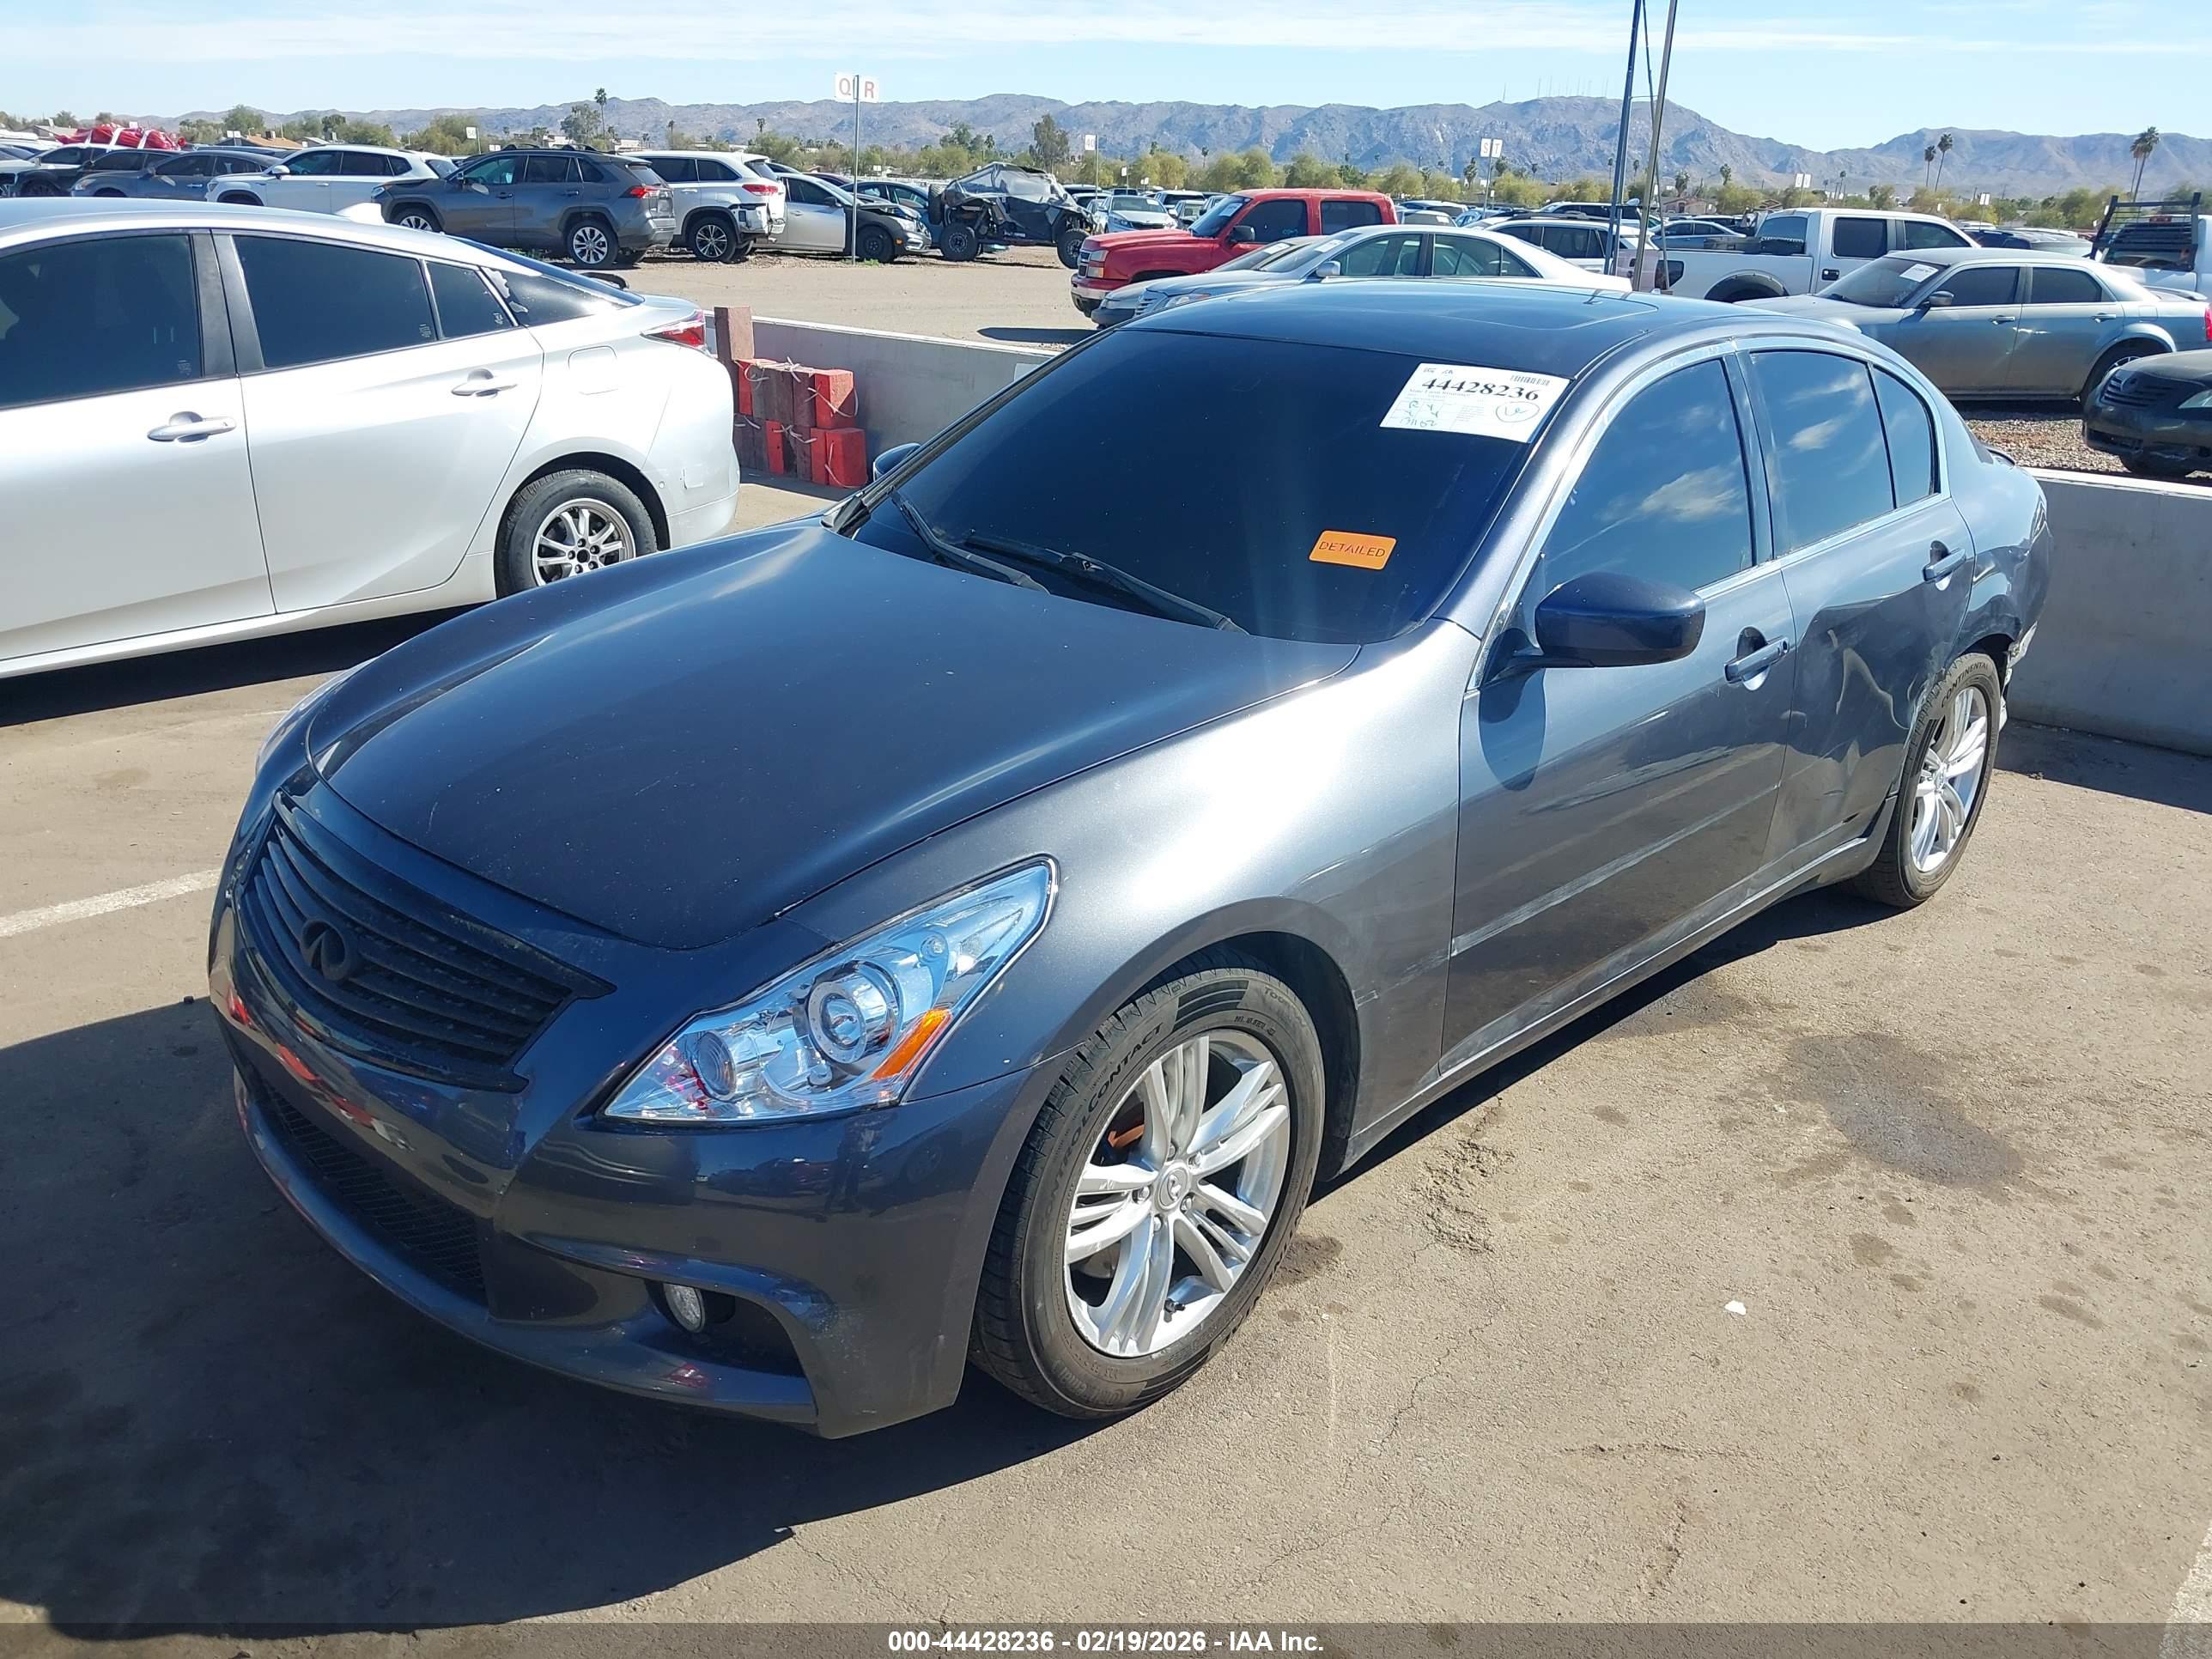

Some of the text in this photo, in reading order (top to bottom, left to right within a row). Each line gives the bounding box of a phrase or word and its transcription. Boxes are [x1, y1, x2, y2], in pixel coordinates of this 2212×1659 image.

[839, 77, 874, 99] Q R
[1483, 143, 1501, 155] S T
[1421, 377, 1540, 401] 44428236
[1318, 541, 1386, 557] DETAILED
[1941, 660, 1989, 708] CONTINENTAL
